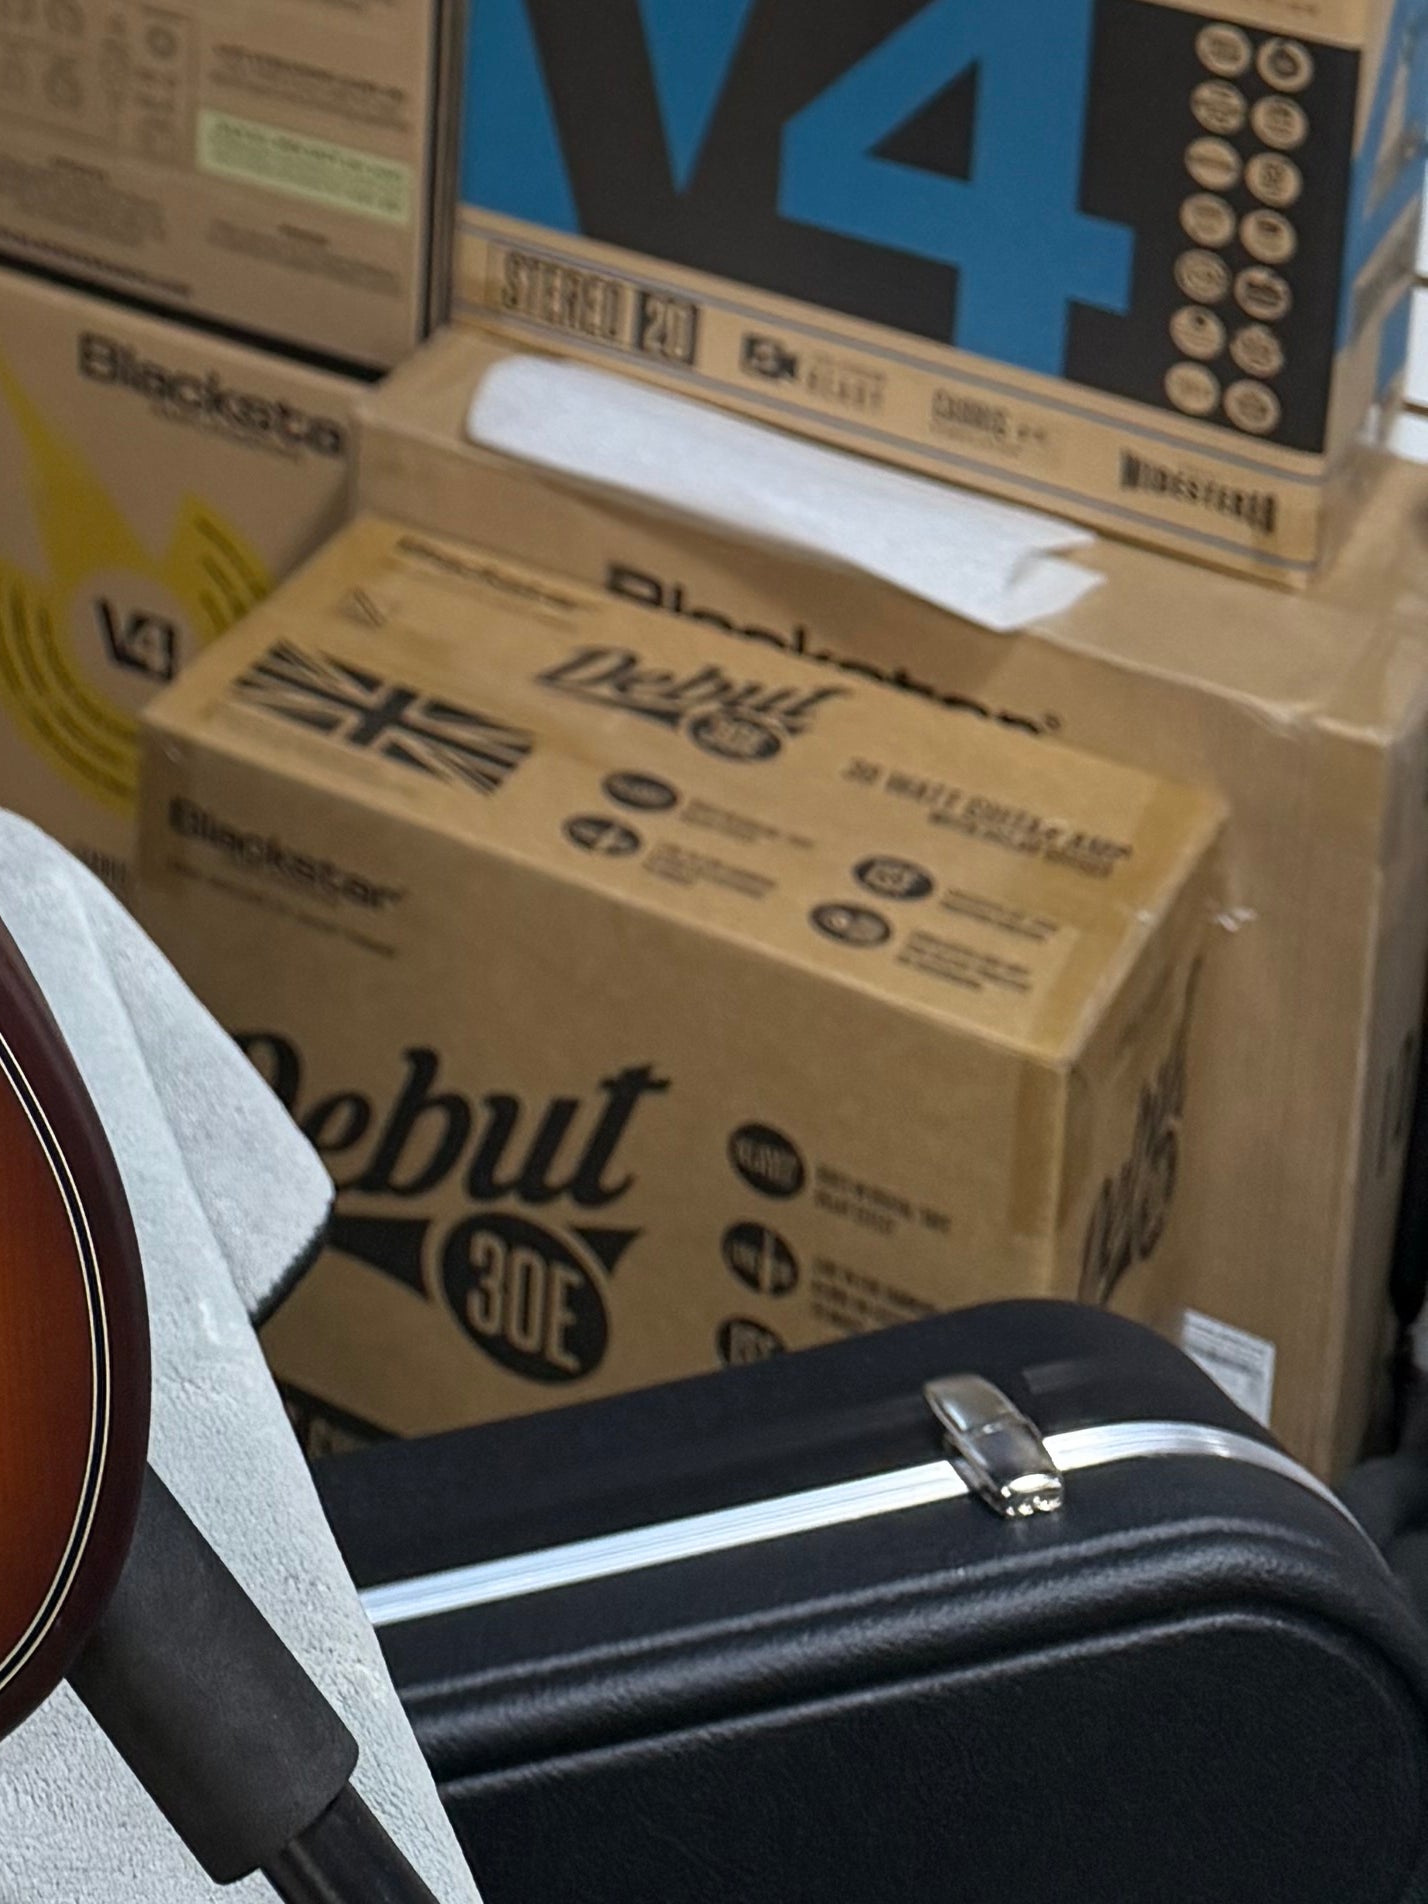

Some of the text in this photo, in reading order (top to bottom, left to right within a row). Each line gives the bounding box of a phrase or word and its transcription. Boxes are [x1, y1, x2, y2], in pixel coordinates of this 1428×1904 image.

[77, 331, 345, 460] Blacksta
[534, 644, 852, 720] Debut
[166, 795, 403, 909] Blackstar
[466, 1228, 581, 1374] 30E
